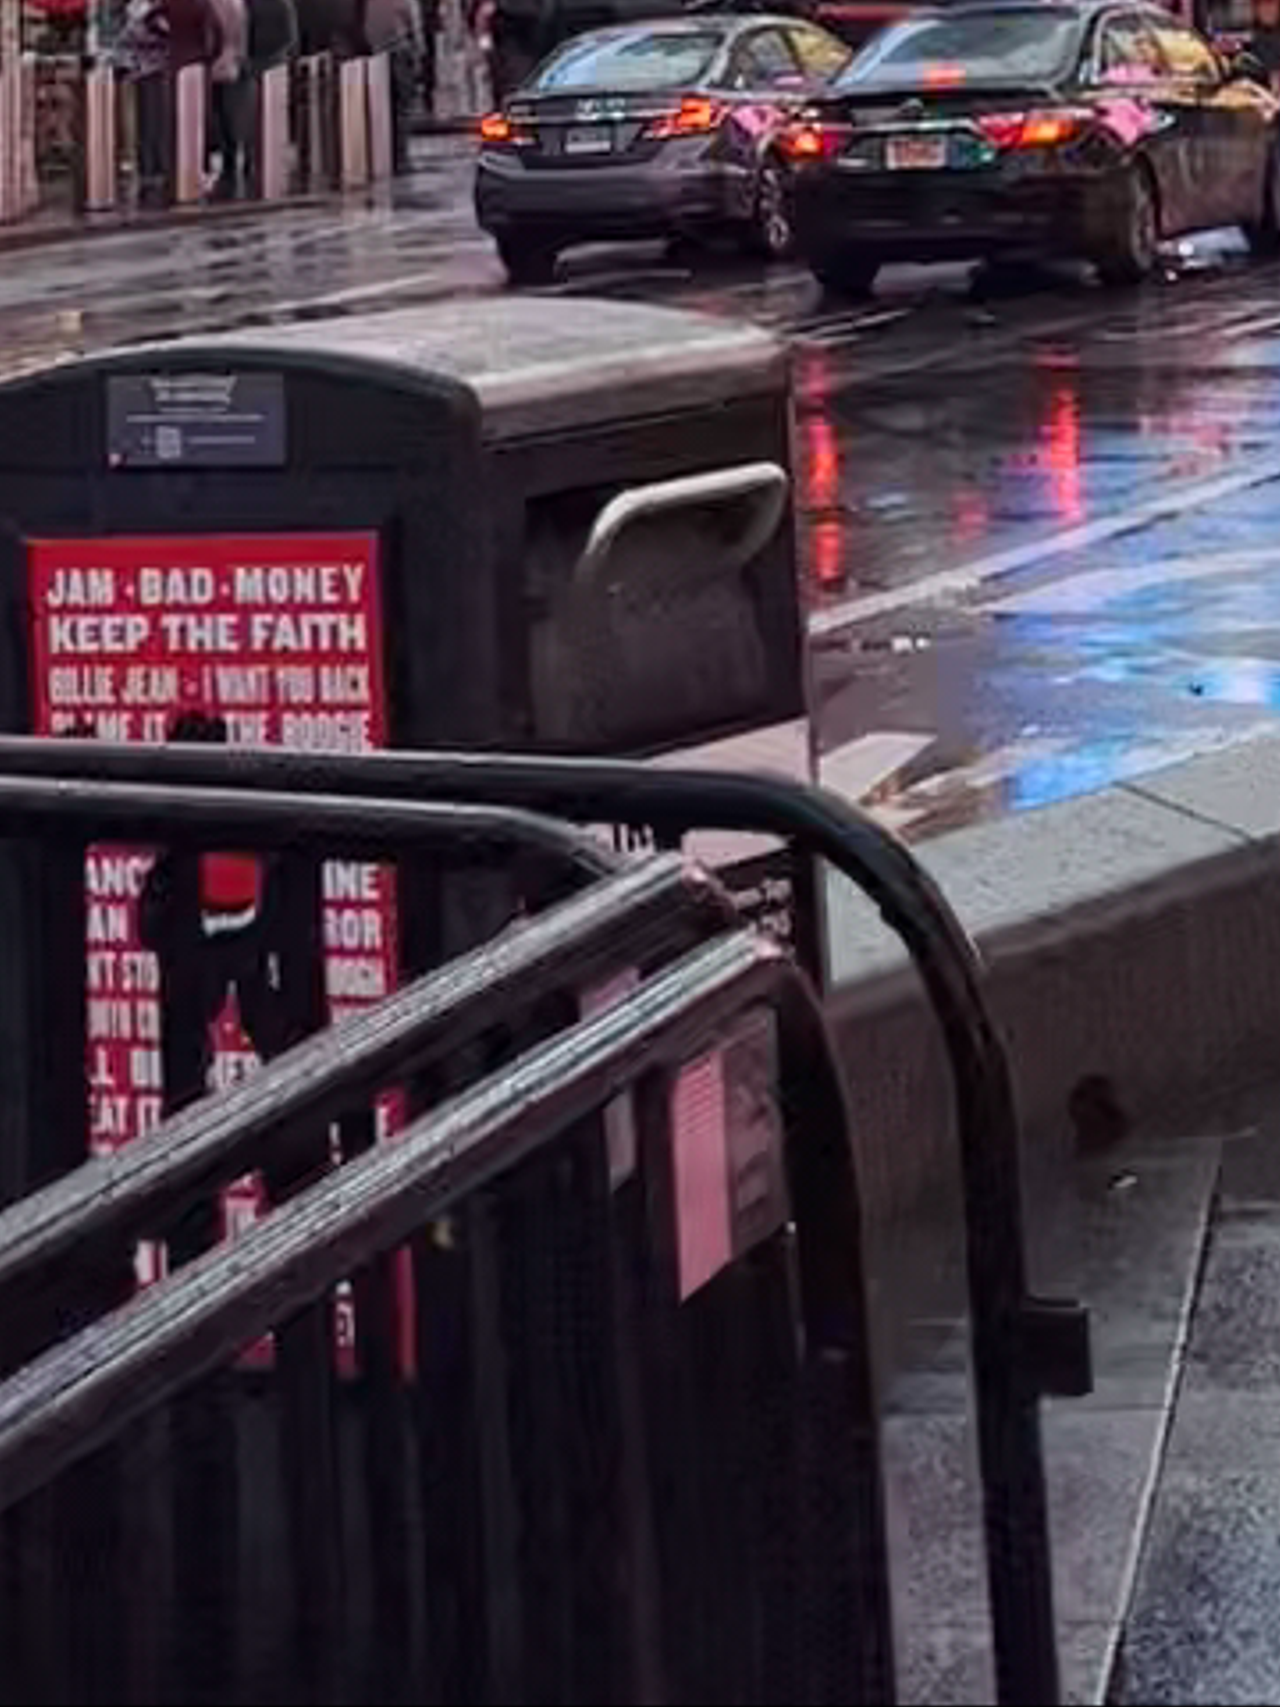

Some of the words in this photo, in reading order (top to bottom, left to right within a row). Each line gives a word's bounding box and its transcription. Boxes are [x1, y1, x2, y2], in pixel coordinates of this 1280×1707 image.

[47, 567, 114, 607] JAM
[139, 567, 214, 606] BAD
[233, 563, 365, 605] MONEY
[48, 613, 150, 654] KEEP
[160, 613, 240, 652] THE
[249, 612, 367, 652] FAITH
[48, 665, 116, 705] BILLIE
[122, 665, 179, 705] JEAN
[215, 665, 271, 704] WANT
[320, 665, 371, 705] BACK
